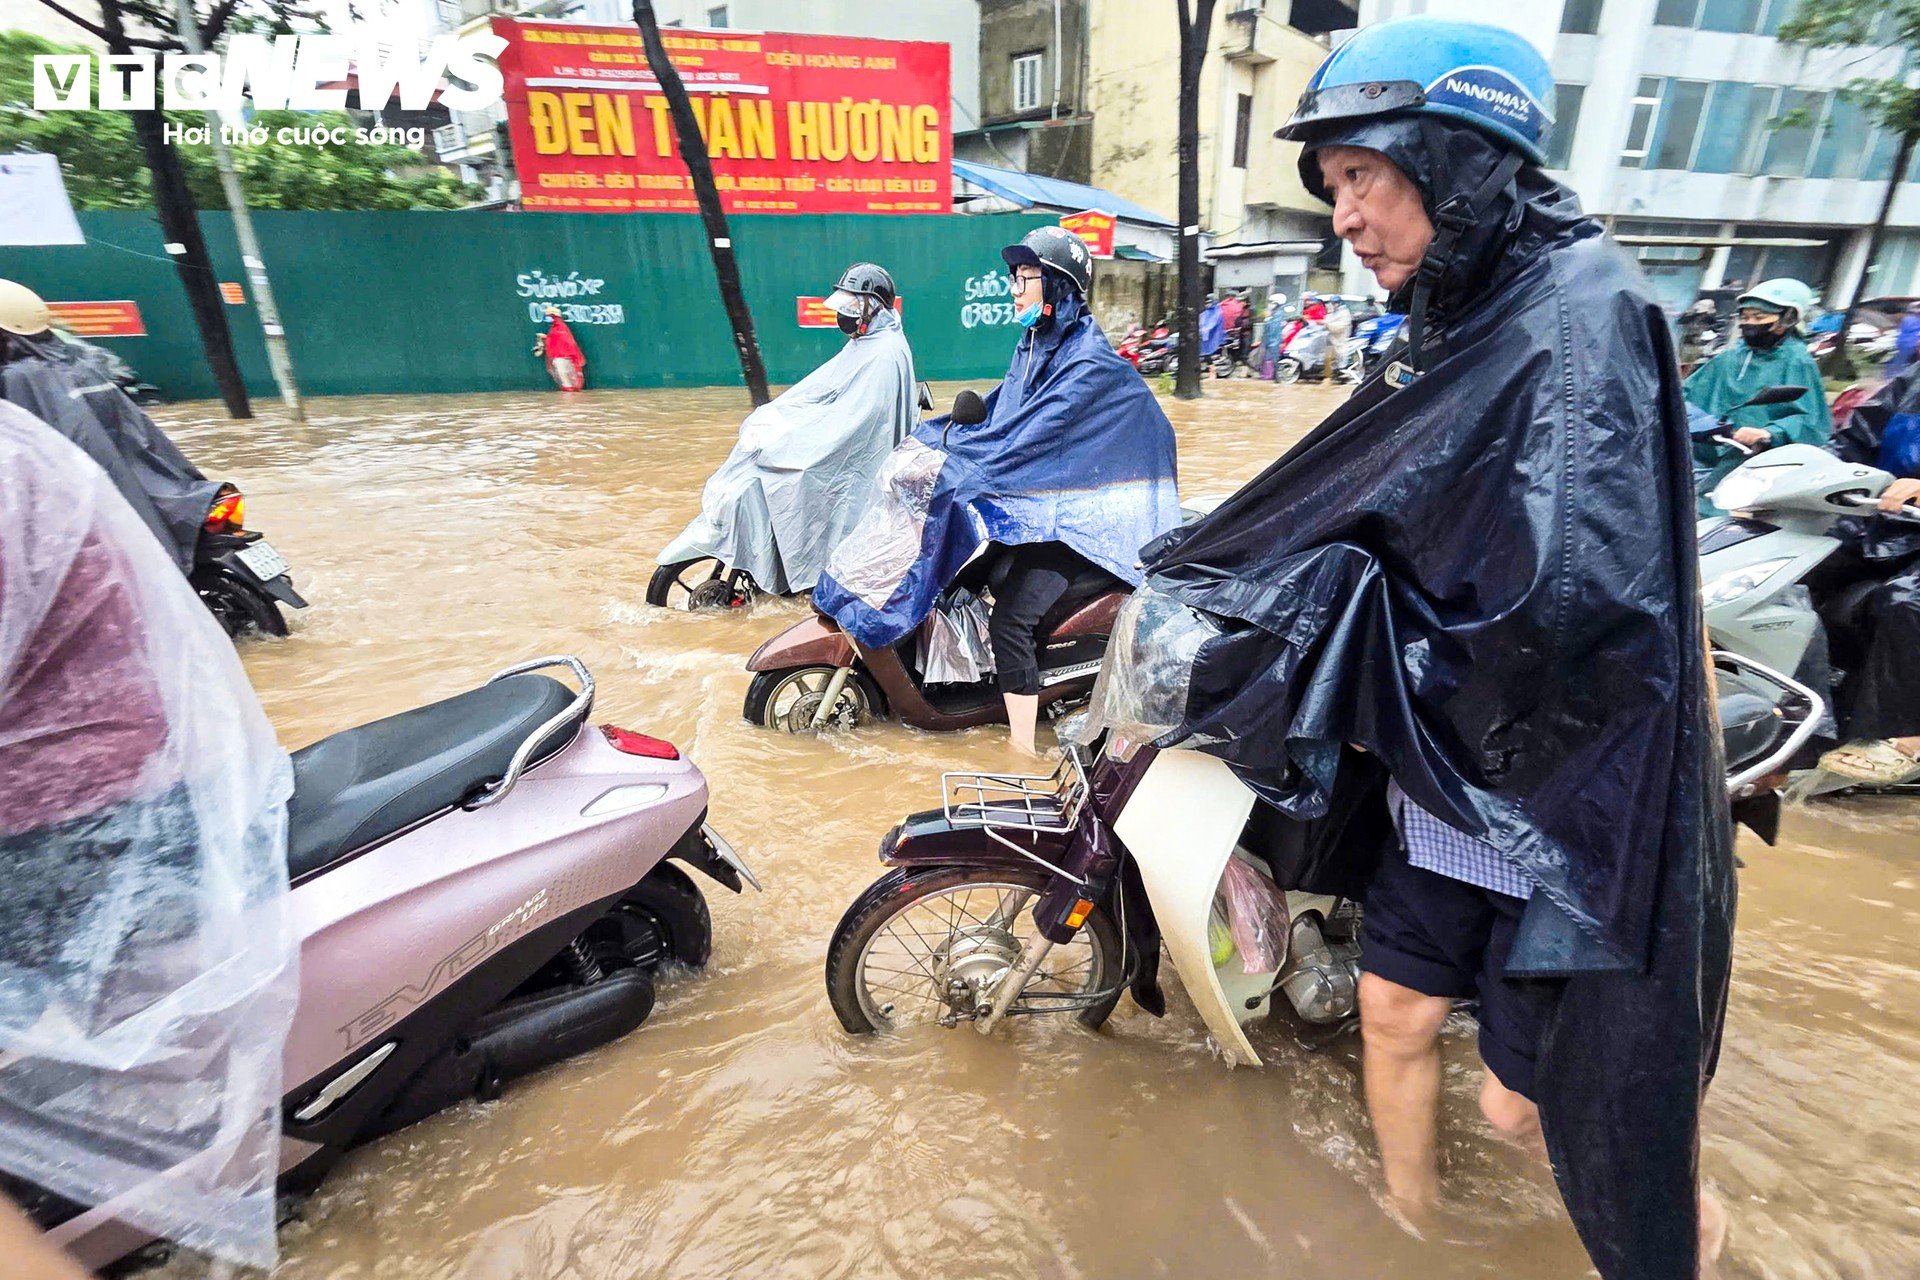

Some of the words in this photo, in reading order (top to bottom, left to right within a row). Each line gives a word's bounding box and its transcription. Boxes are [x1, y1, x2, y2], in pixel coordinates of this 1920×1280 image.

[1446, 78, 1531, 113] NANOMAX
[787, 96, 940, 164] HƯƠNG
[913, 179, 937, 193] LED
[338, 926, 500, 1051] EVO
